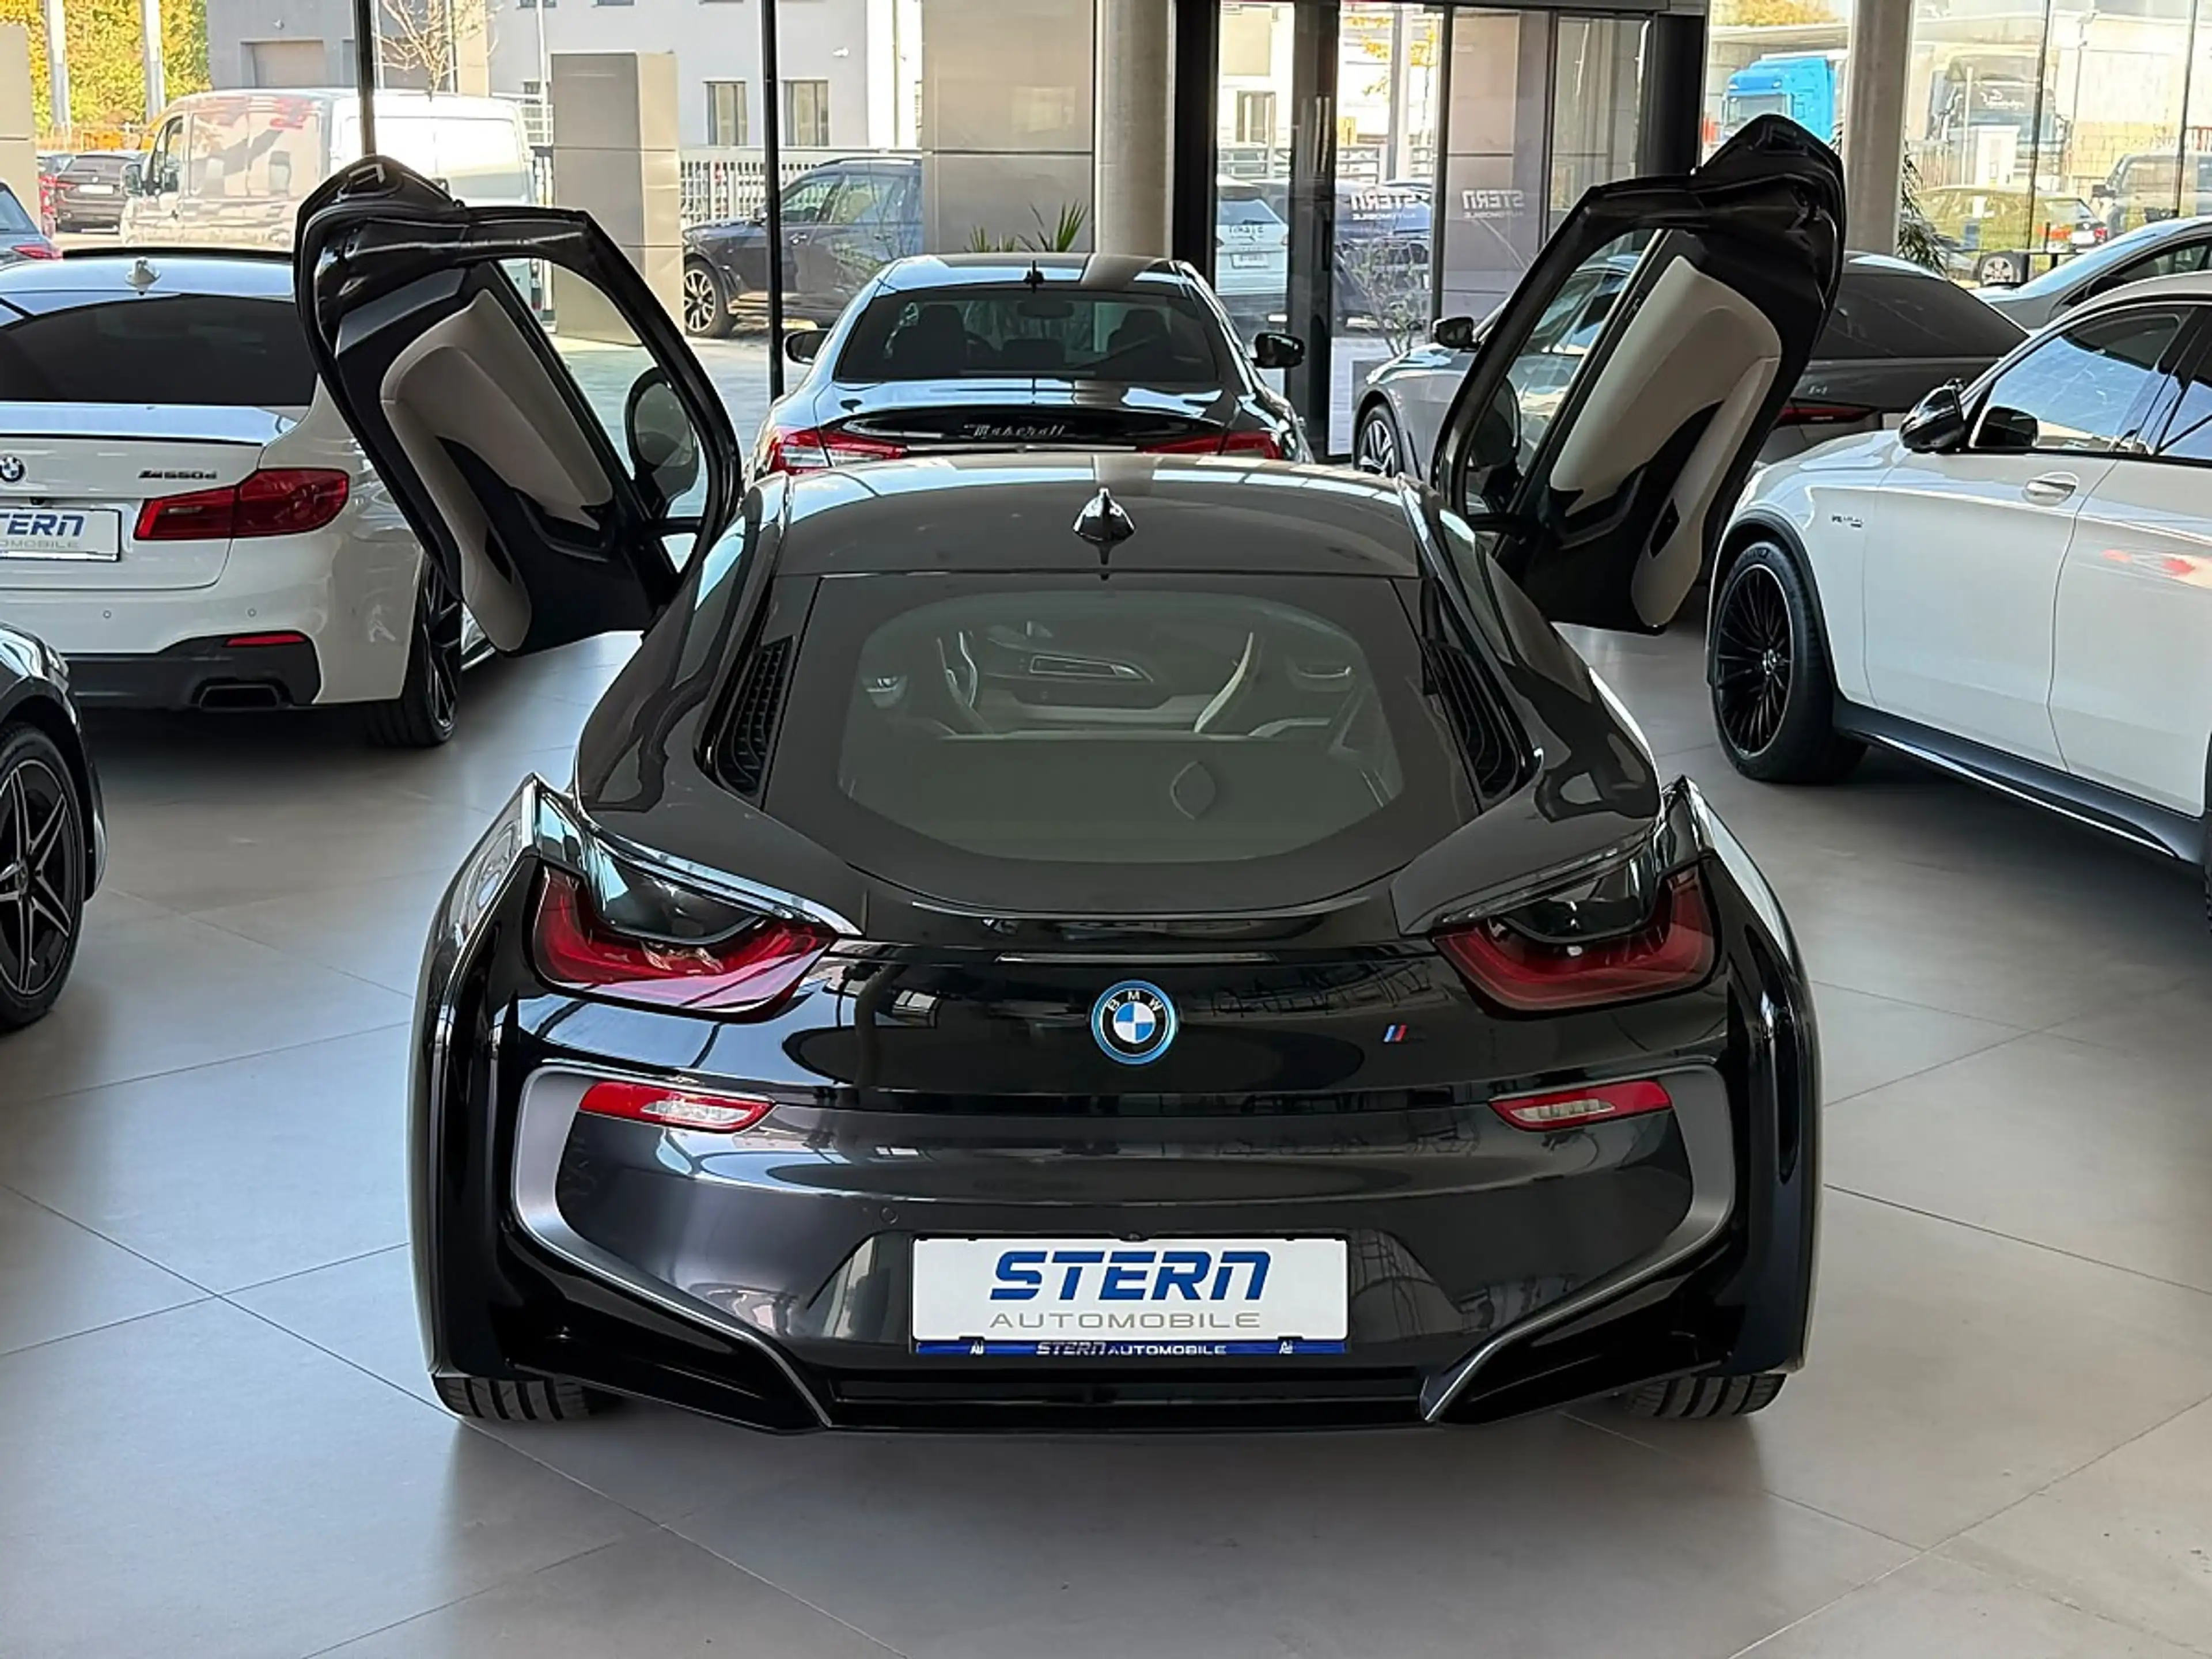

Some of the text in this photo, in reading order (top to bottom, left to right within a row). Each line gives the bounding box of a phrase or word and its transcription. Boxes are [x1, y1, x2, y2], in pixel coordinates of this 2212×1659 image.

[1106, 991, 1164, 1012] BMW
[989, 1251, 1271, 1300] STERN
[989, 1312, 1260, 1328] AUTOMOBILE
[1036, 1342, 1106, 1355] STERN
[1108, 1345, 1227, 1355] AUTOMOBILE
